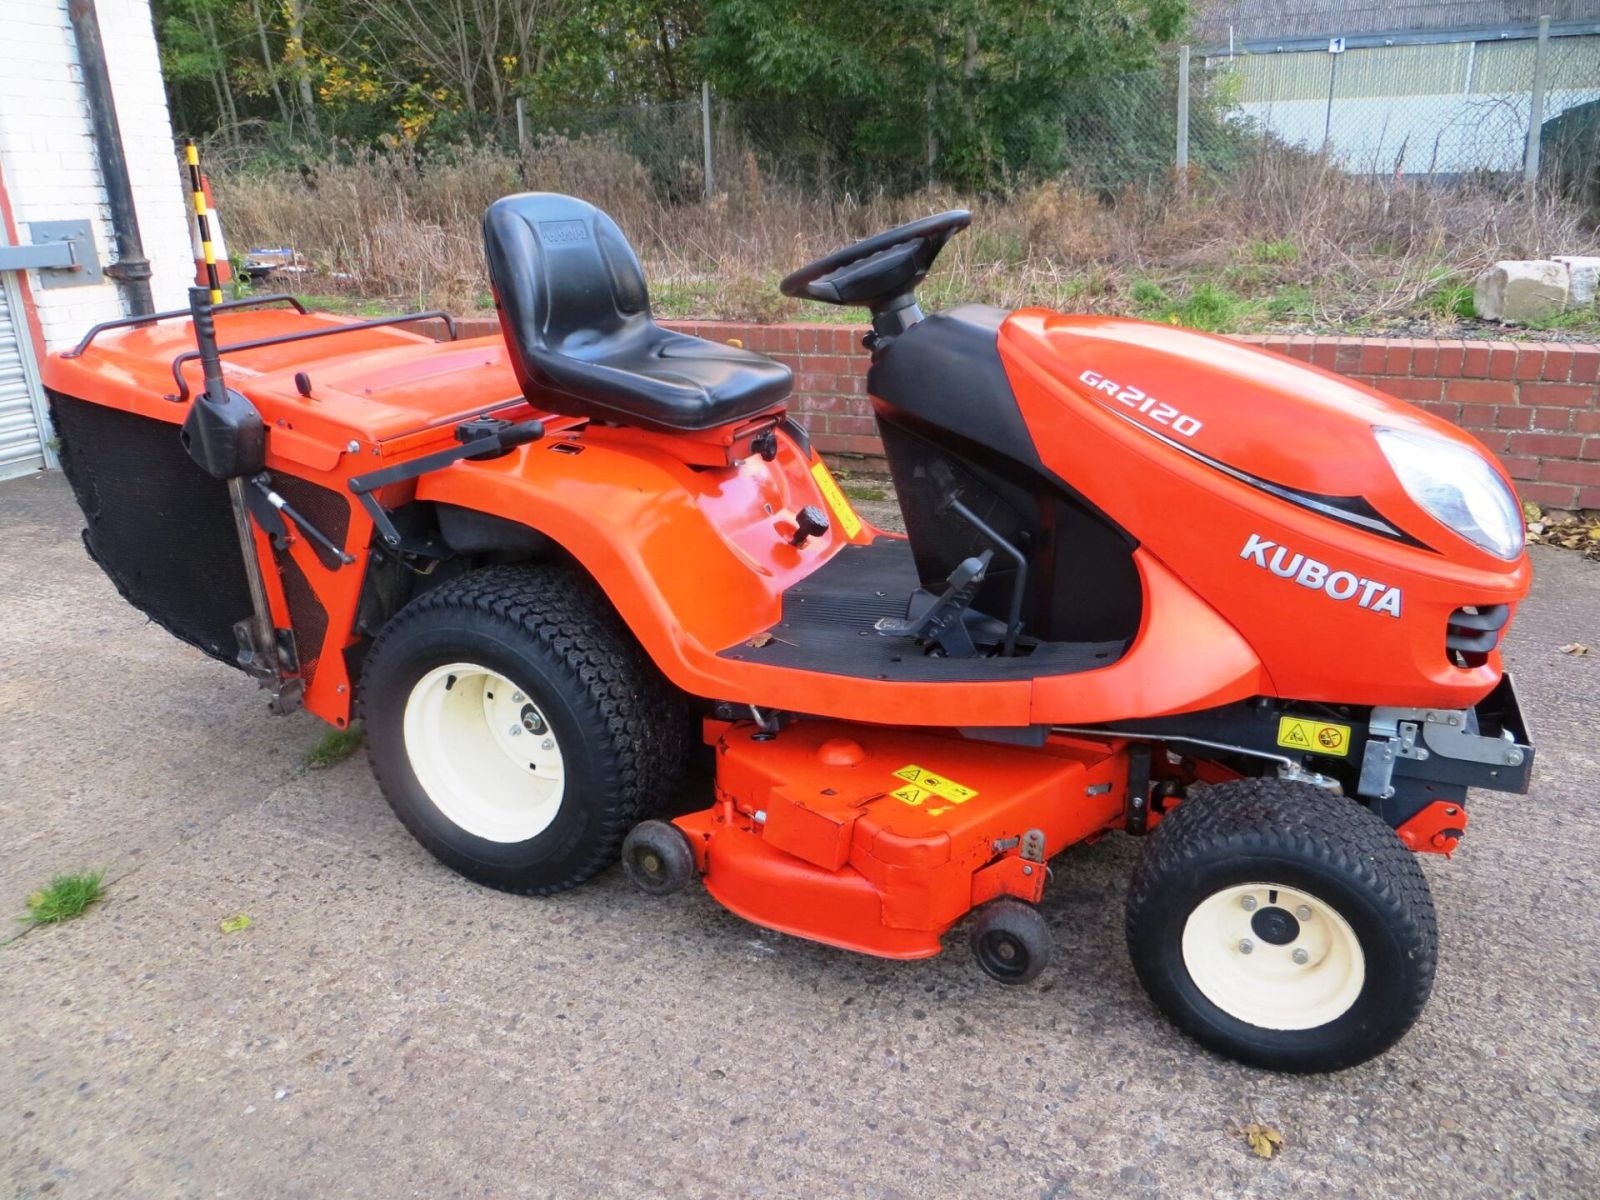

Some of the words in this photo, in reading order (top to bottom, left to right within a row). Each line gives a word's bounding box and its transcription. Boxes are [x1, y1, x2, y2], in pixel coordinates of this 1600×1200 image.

[1334, 38, 1342, 51] 1
[1079, 370, 1204, 437] GR2120
[1240, 533, 1403, 618] KUBOTA
